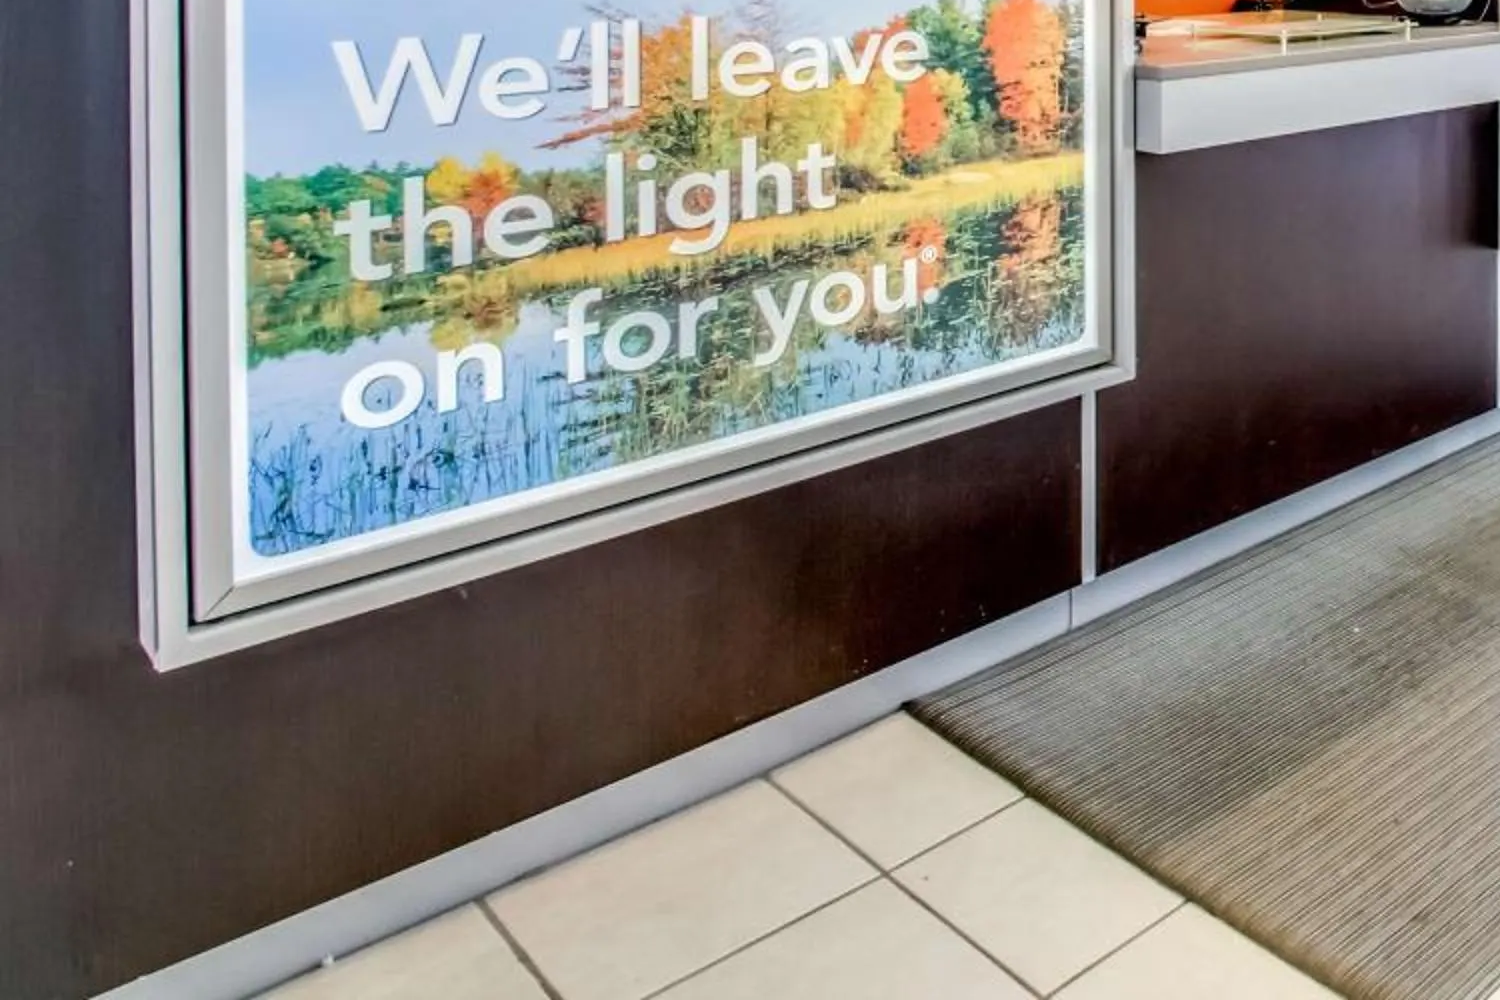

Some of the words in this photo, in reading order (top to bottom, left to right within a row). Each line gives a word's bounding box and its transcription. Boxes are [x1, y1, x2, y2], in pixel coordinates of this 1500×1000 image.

[331, 16, 642, 133] We'll
[691, 14, 930, 102] leave
[333, 175, 555, 283] the
[605, 136, 838, 256] light
[340, 337, 503, 429] on
[554, 288, 720, 384] for
